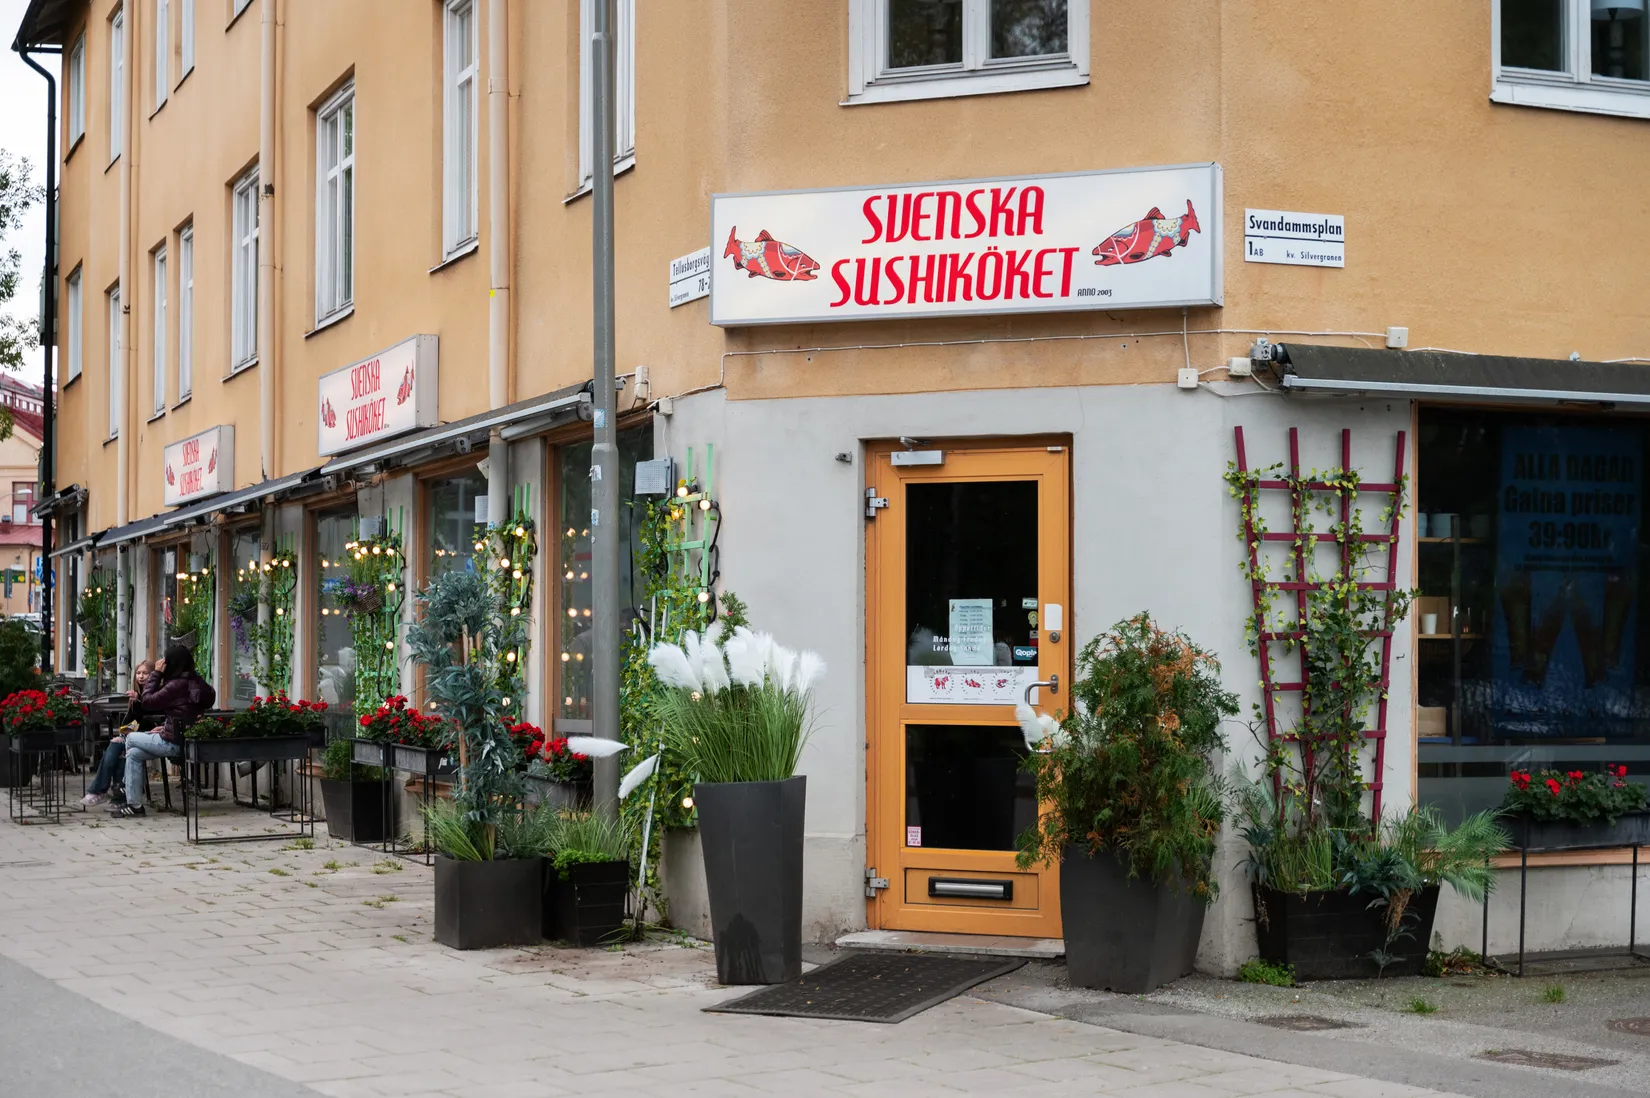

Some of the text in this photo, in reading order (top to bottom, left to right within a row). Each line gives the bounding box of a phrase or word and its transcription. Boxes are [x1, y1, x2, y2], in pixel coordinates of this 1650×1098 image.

[862, 186, 1045, 245] SVENSKA
[1249, 214, 1342, 238] Svandammsplan
[830, 246, 1080, 308] SUSHIKÖKET
[1077, 287, 1113, 297] ANNO 2003
[351, 359, 381, 401] SVENSKA
[345, 397, 387, 442] SUSHIKÖKET
[1513, 453, 1562, 481] ALLA
[1570, 488, 1637, 517] priser
